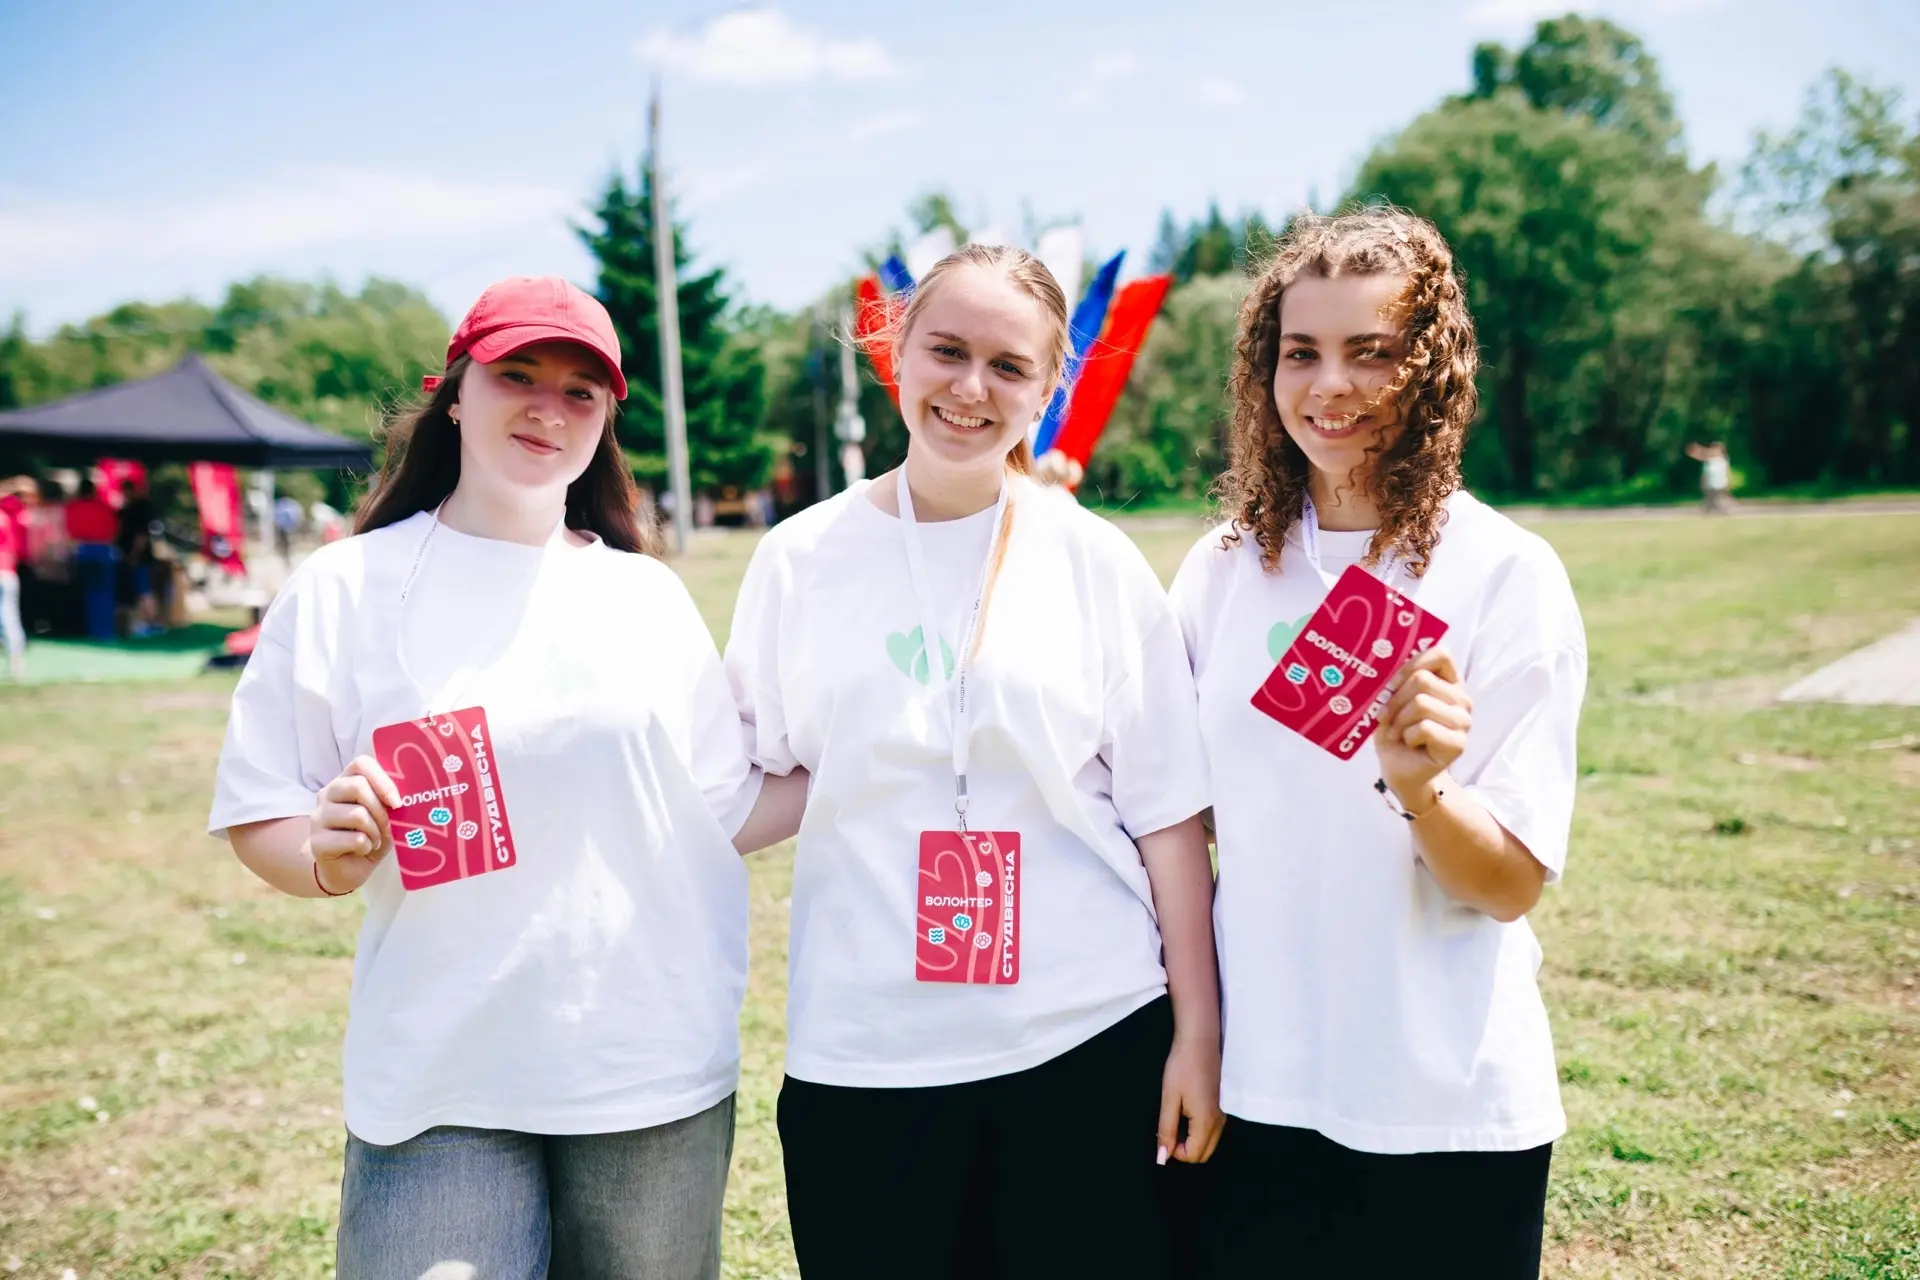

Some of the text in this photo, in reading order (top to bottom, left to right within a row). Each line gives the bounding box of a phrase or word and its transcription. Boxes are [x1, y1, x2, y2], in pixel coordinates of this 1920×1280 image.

[1304, 629, 1378, 679] ВОЛОНТЕР
[400, 782, 469, 807] ОЛОНТЕР
[470, 723, 510, 863] СТУДВЕСНА
[925, 895, 993, 908] ВОЛОНТЕР
[1002, 850, 1016, 978] СТУДВЕСНА
